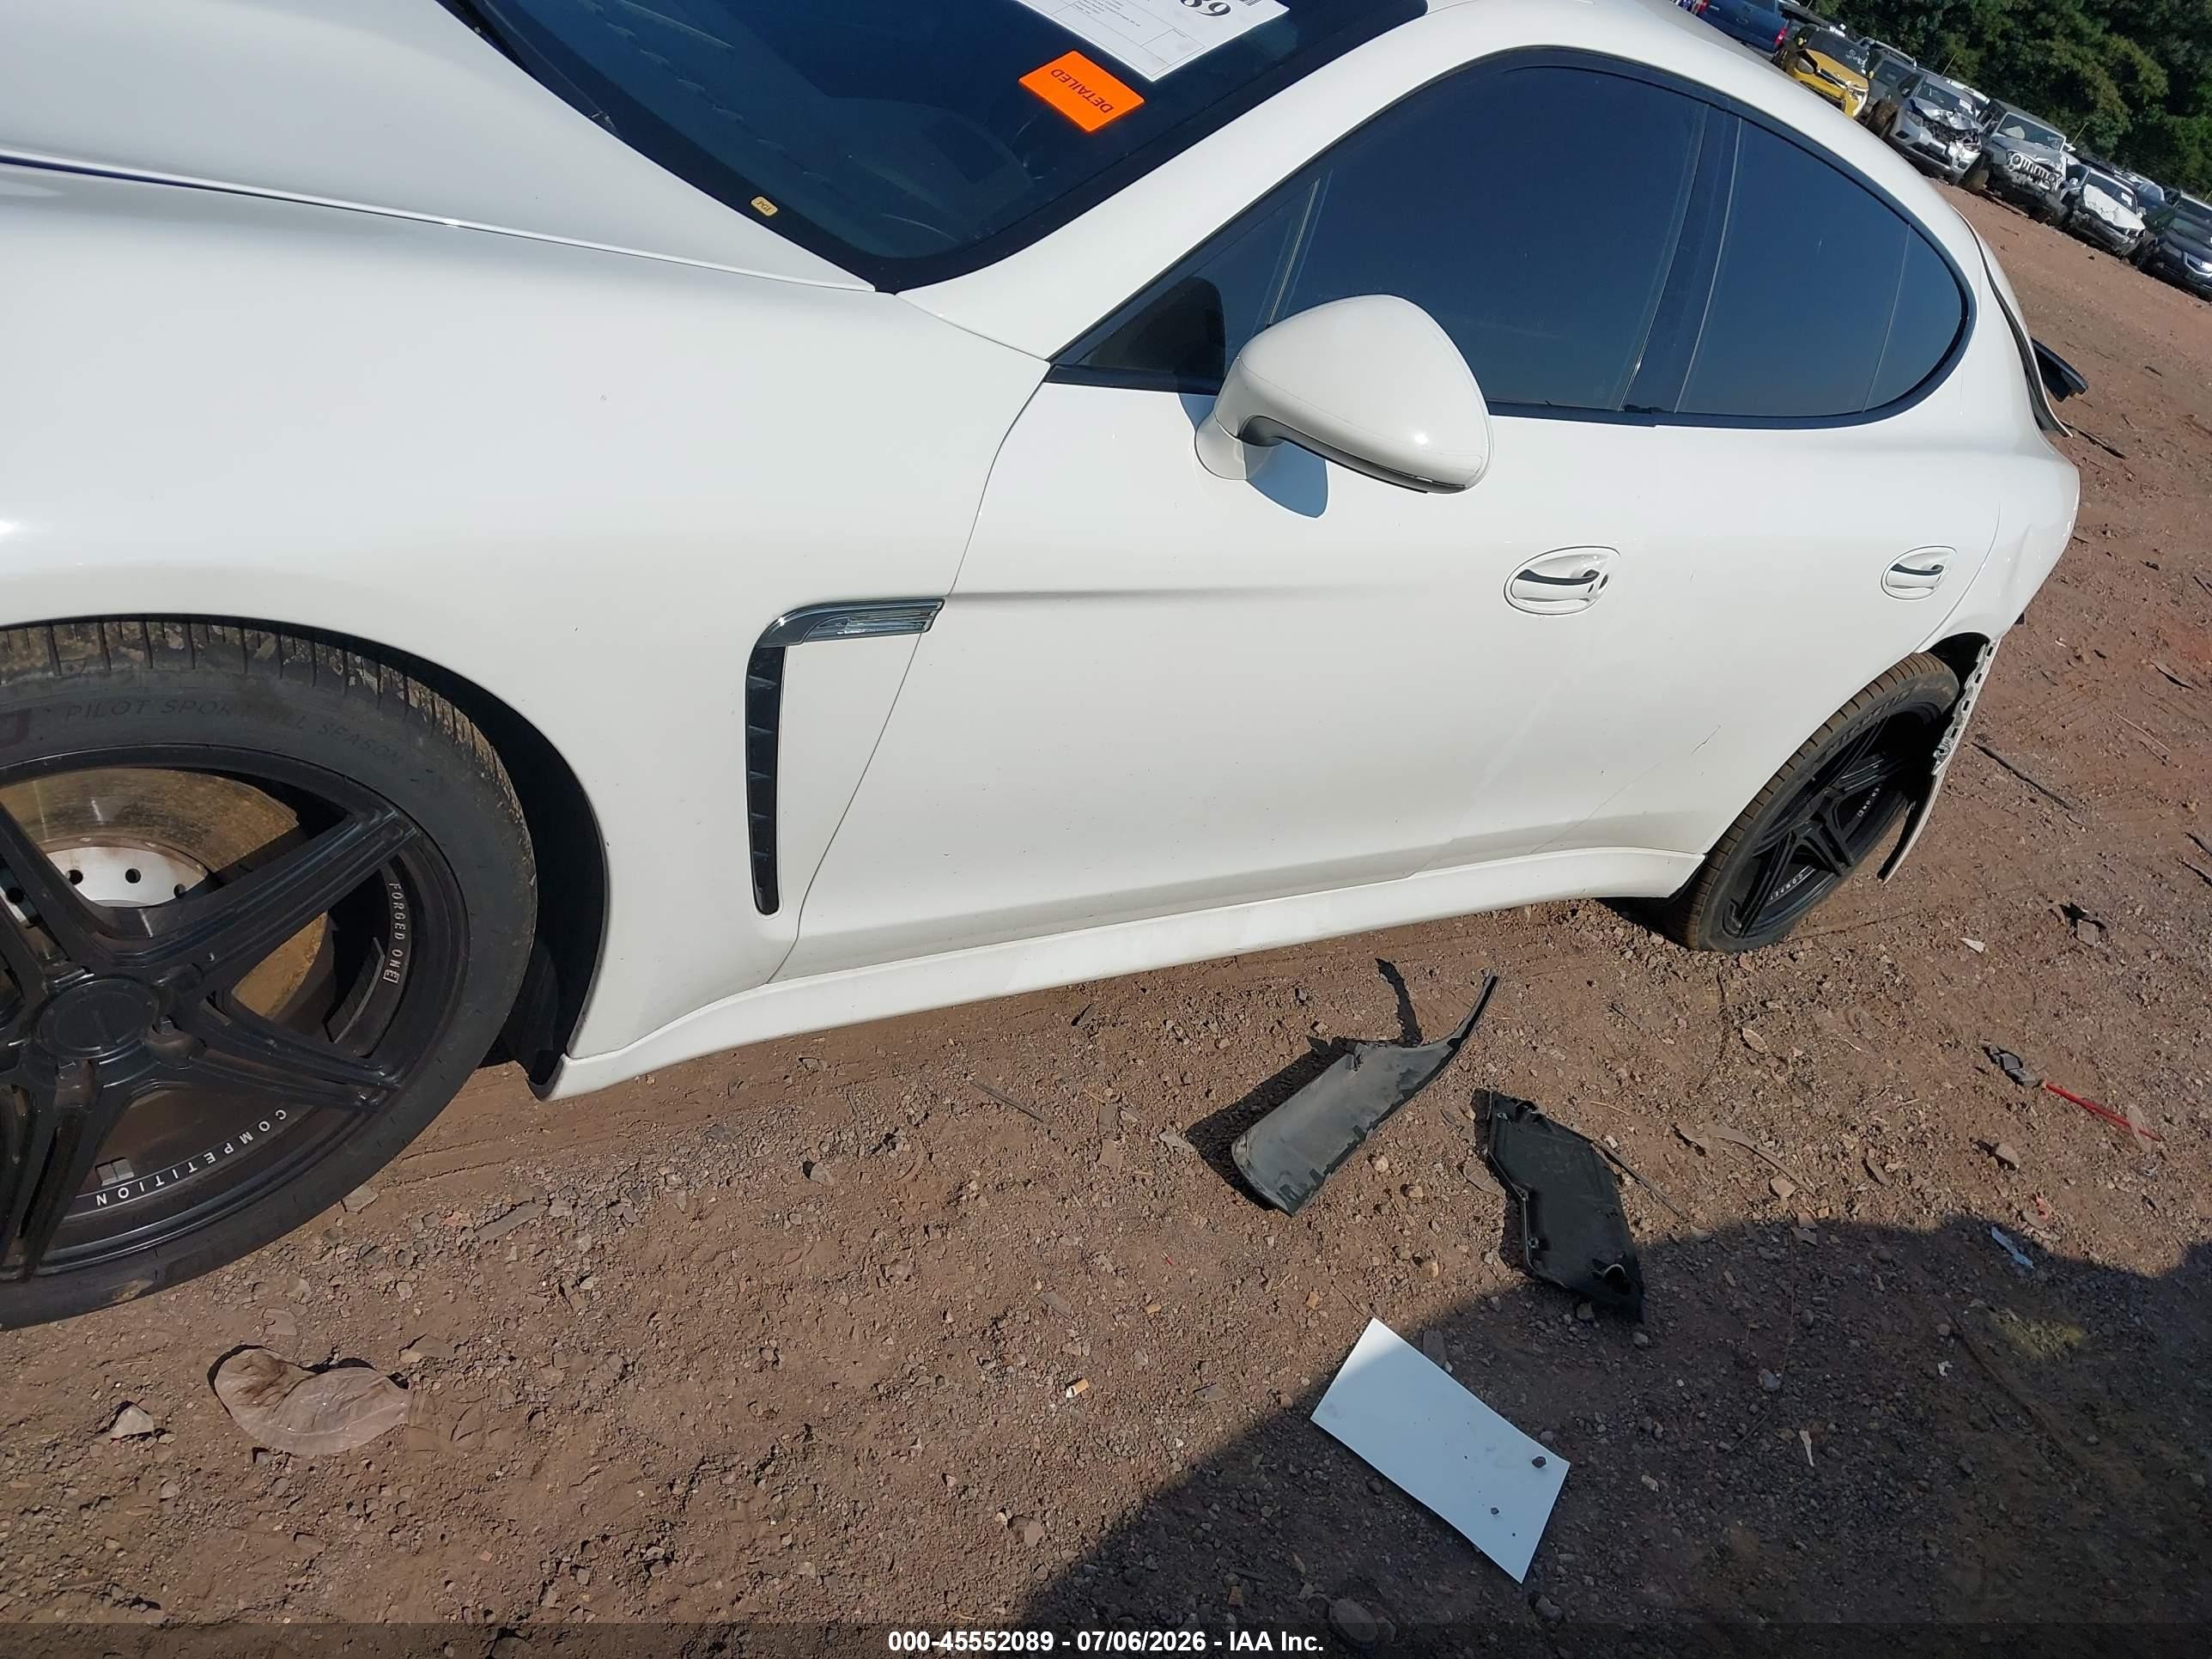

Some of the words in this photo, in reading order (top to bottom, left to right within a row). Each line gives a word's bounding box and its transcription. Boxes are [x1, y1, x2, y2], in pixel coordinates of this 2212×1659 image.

[1050, 69, 1115, 113] DETAILED
[65, 699, 152, 721] PILOT
[161, 699, 252, 717] SPOR
[388, 883, 406, 940] FORGED
[382, 949, 404, 983] ONE
[95, 1109, 287, 1206] COMPETITION
